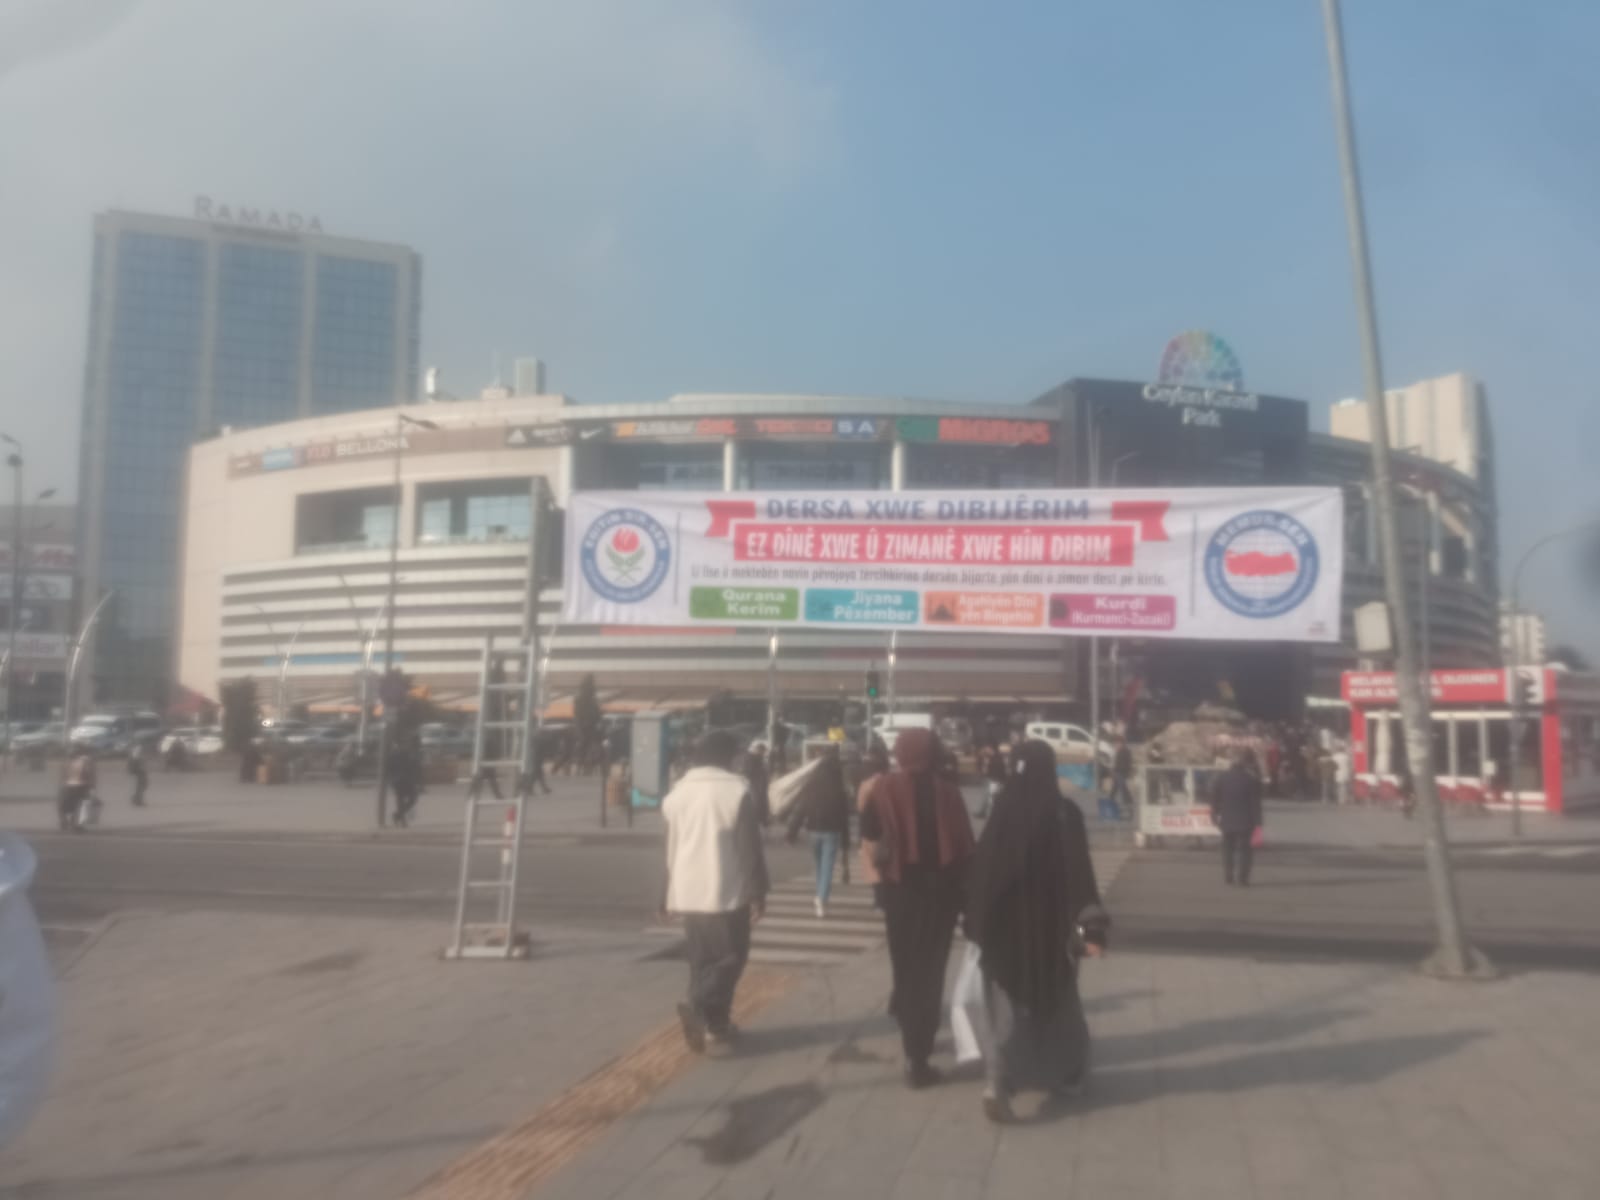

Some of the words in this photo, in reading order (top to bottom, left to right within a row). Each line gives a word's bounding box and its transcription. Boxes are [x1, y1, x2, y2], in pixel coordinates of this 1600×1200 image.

[194, 194, 323, 232] RAMADA
[336, 437, 410, 457] BELLONA
[767, 498, 855, 519] DERSA
[864, 499, 926, 520] XWE
[937, 493, 1089, 521] DIBIJÊRIM
[746, 532, 767, 557] EZ
[772, 526, 815, 559] DÎNÊ
[820, 533, 860, 559] XWE
[865, 527, 879, 560] Û
[884, 527, 955, 561] ZIMANÊ
[961, 534, 1004, 561] XWE
[1009, 528, 1044, 562] HÎN
[1050, 534, 1111, 562] DIBIM
